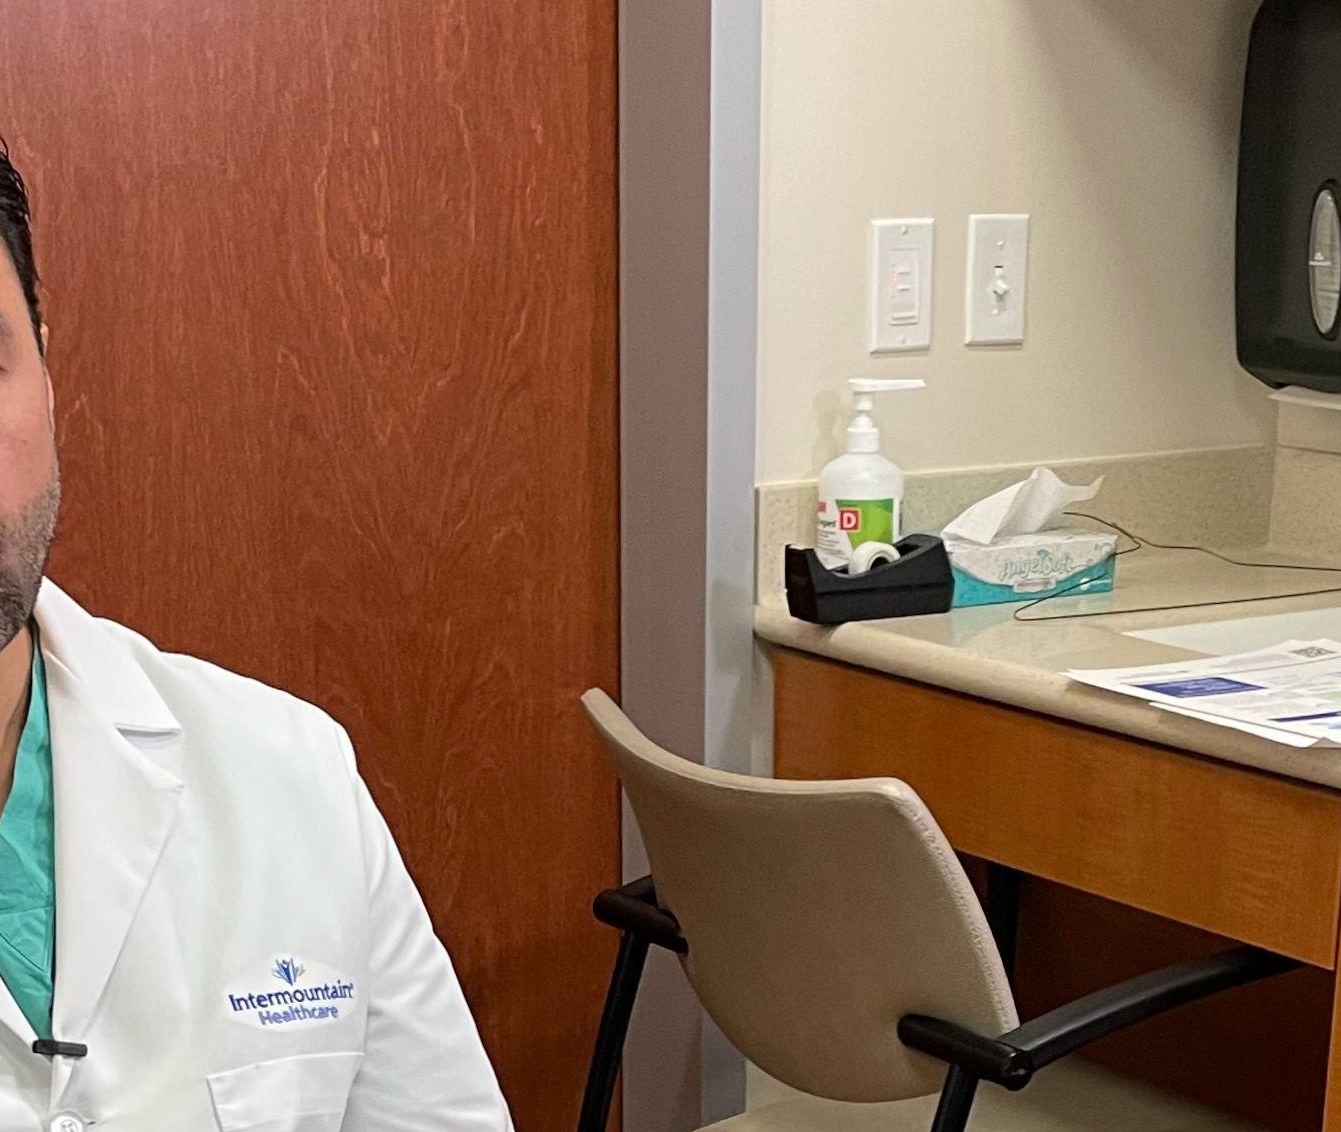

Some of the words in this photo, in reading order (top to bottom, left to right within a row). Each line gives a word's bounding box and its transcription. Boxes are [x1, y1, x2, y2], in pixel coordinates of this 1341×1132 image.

[842, 512, 857, 529] D
[228, 980, 354, 1011] Intermountain
[258, 1004, 338, 1025] Healthcare
